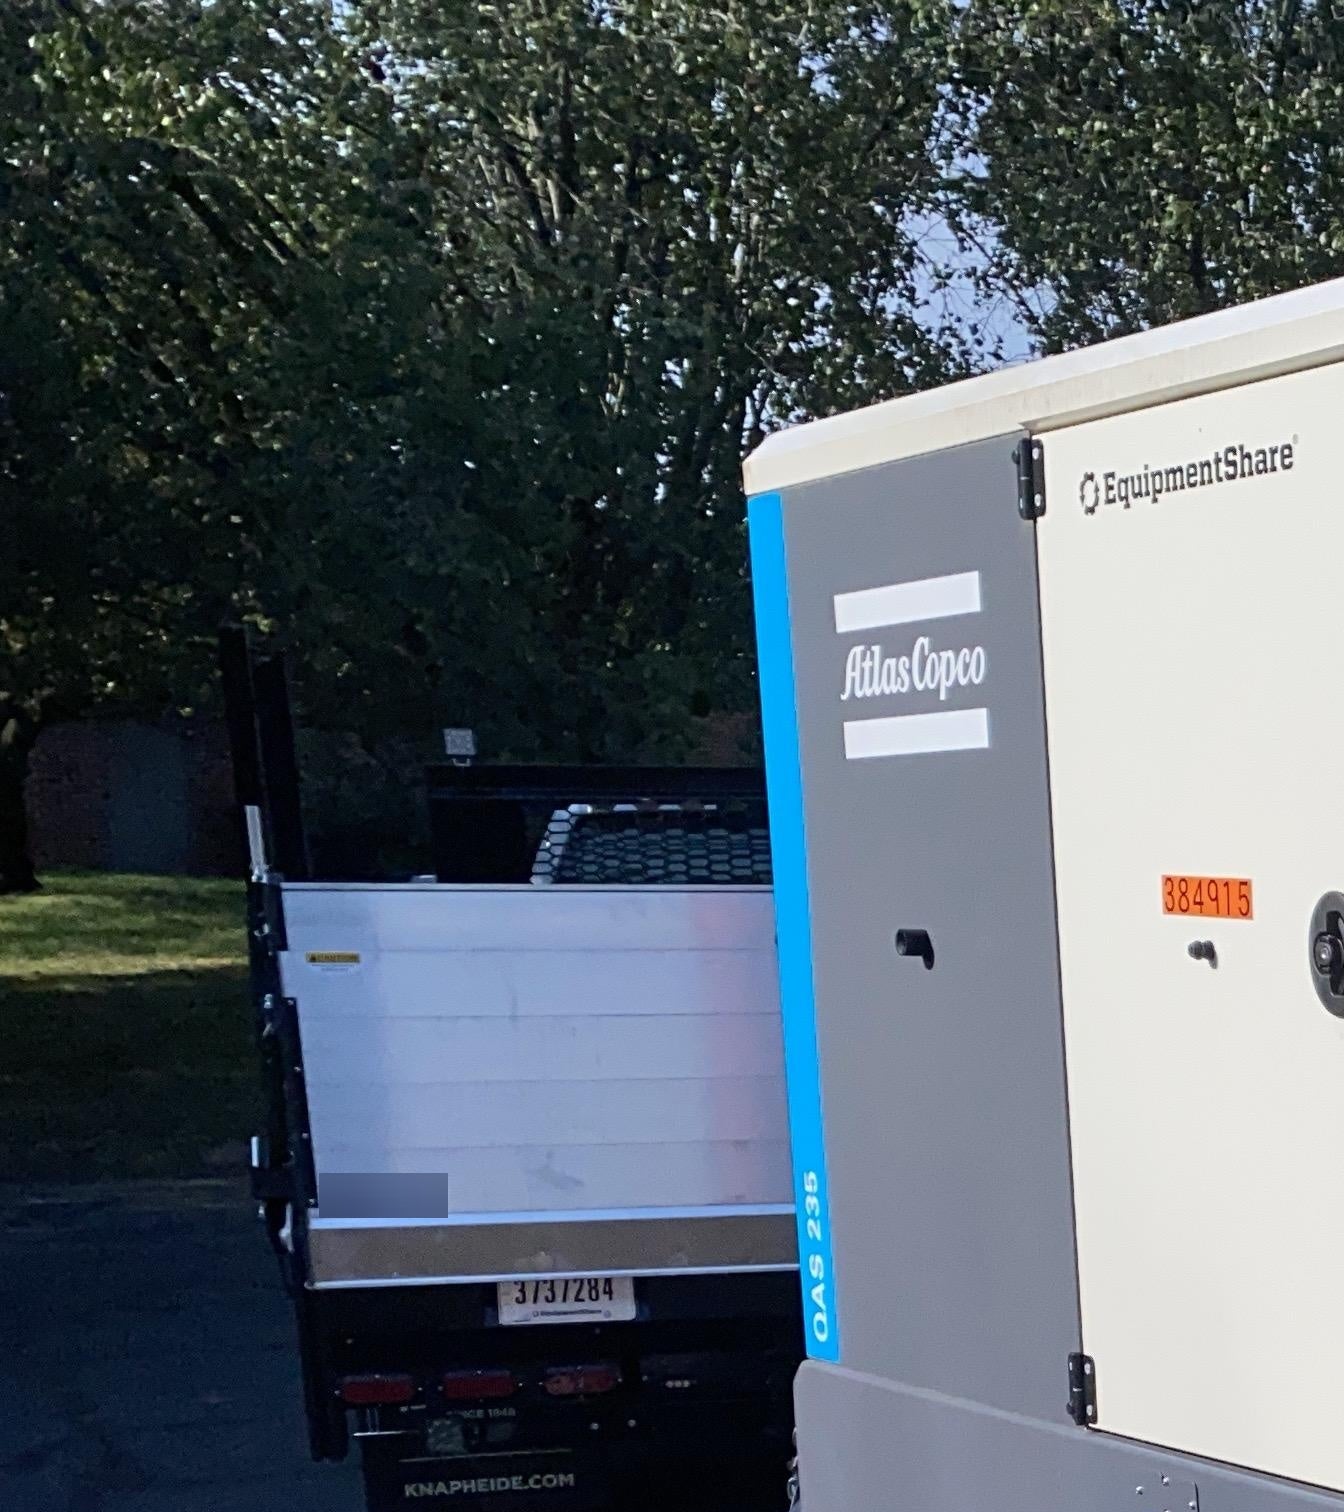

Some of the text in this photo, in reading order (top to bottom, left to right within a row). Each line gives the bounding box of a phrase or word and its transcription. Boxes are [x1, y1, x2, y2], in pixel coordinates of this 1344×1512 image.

[1103, 443, 1294, 509] EquipmentShare
[840, 636, 986, 701] Atlas Copco
[1165, 877, 1250, 917] 384915
[803, 1170, 829, 1343] QAS 235
[404, 1473, 575, 1498] KNAPHEIDE.COM
